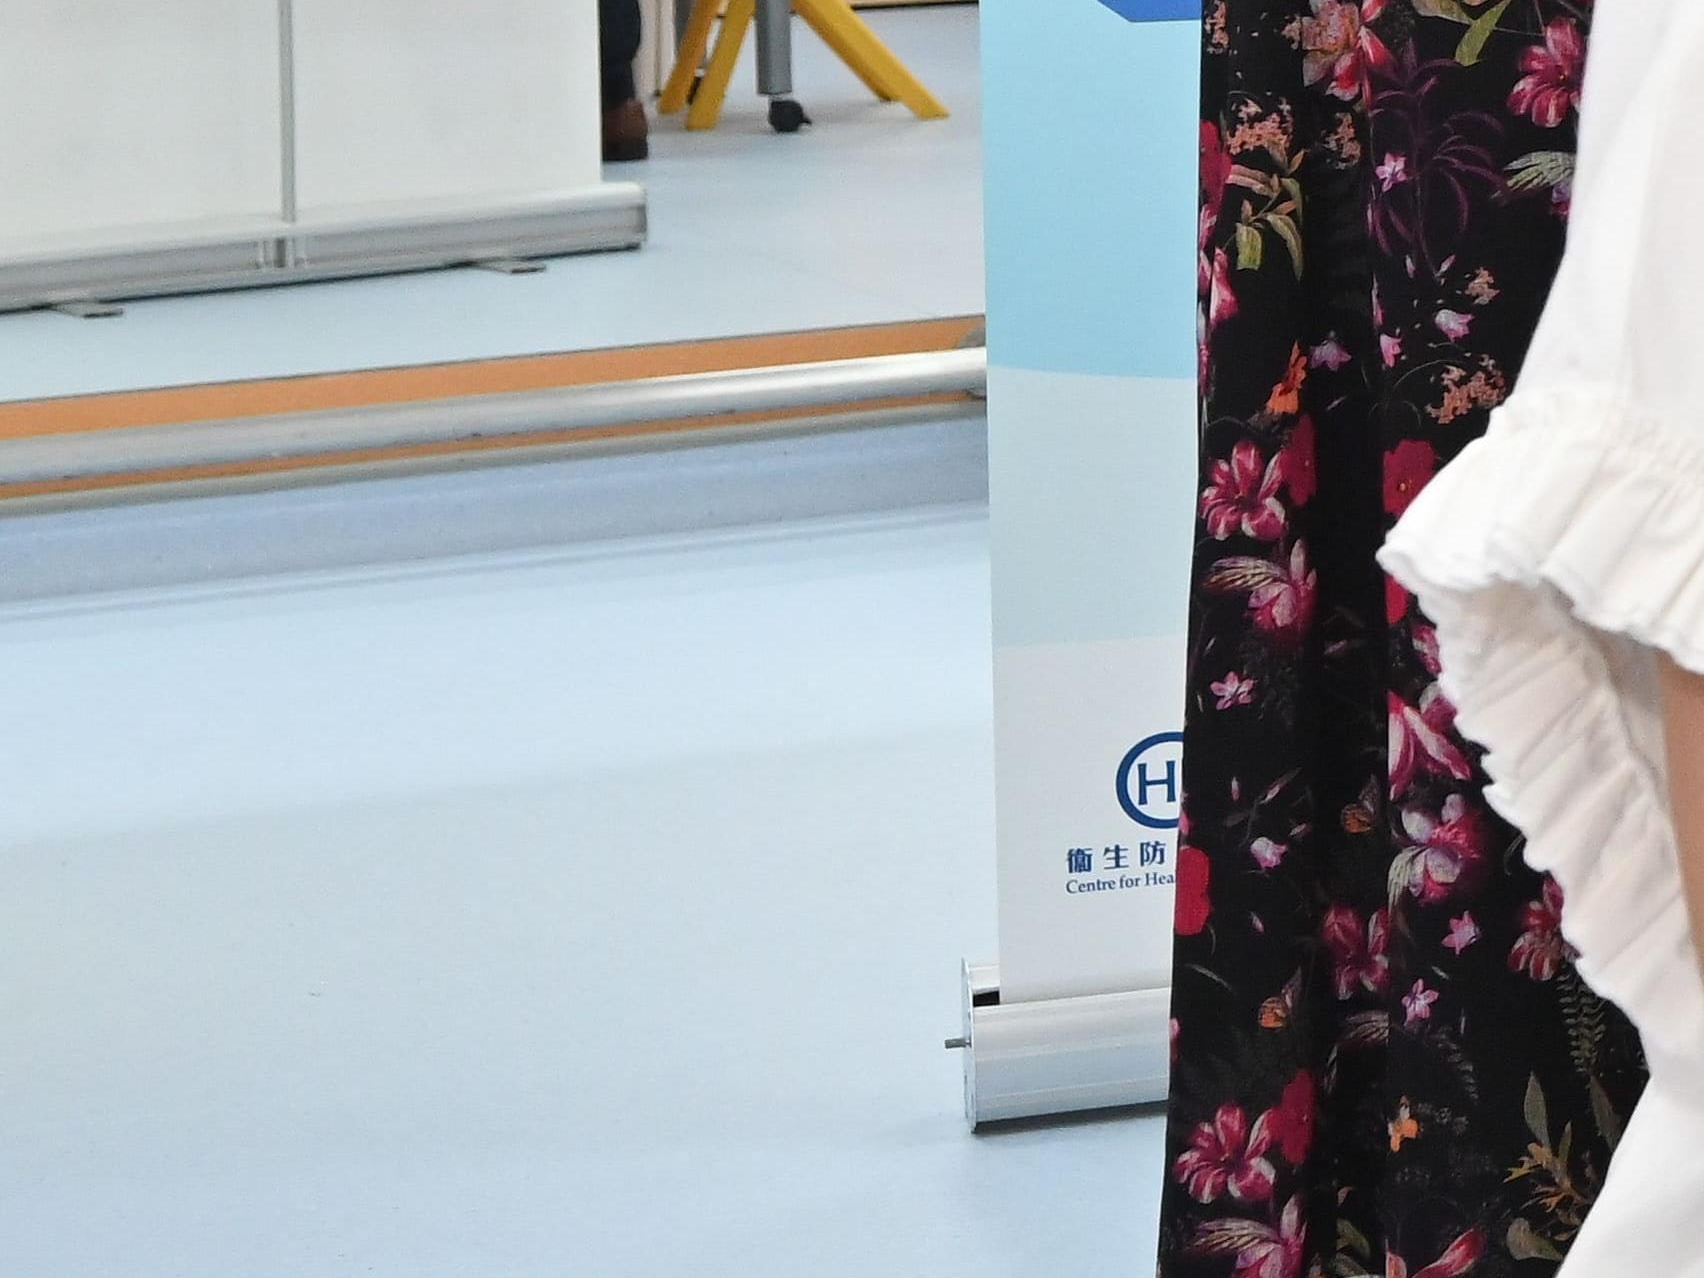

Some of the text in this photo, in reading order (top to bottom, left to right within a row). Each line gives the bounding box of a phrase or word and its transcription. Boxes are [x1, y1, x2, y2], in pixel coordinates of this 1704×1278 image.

[1066, 872, 1175, 894] Centre for Hea
